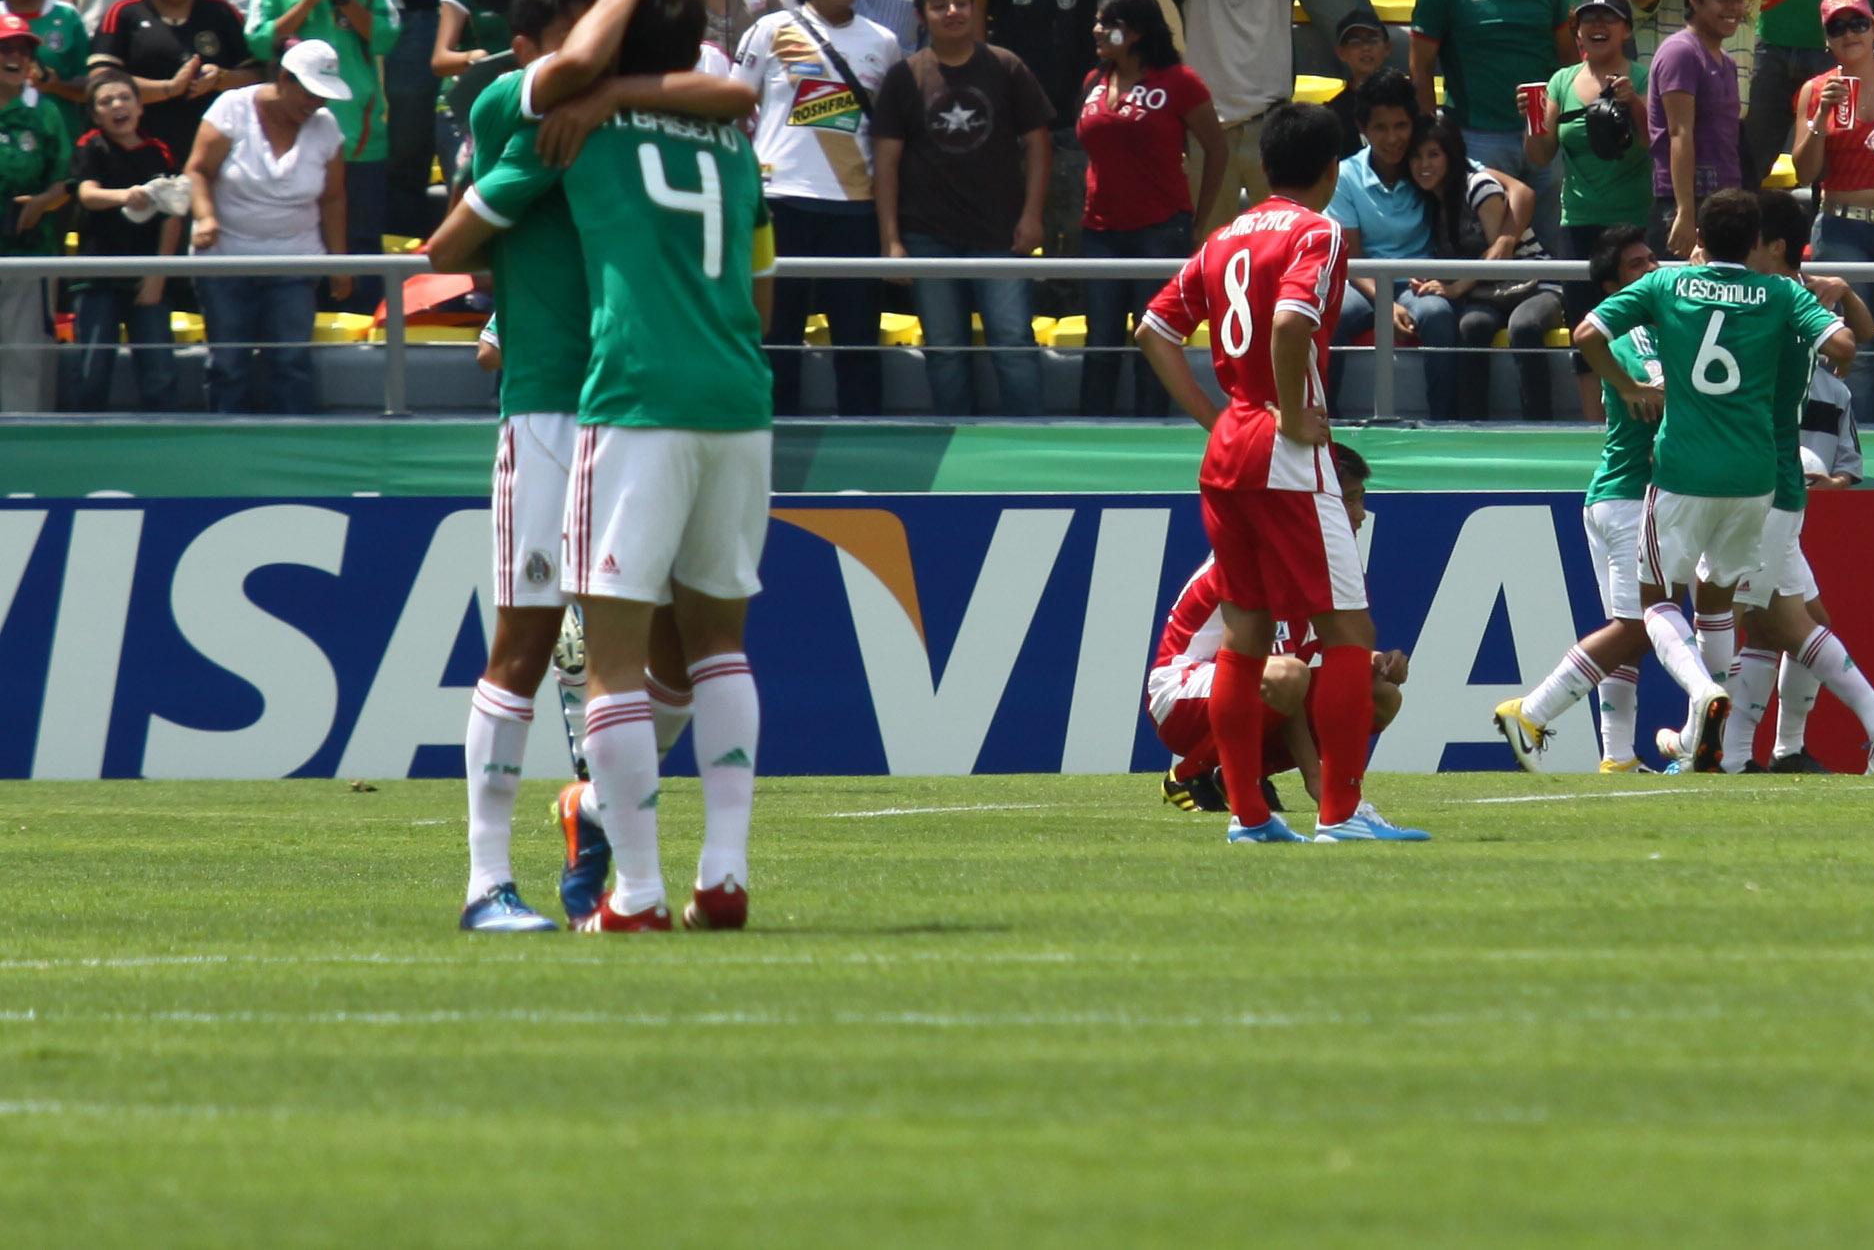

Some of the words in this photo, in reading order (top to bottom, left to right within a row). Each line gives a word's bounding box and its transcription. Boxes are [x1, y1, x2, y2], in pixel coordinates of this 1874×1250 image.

[637, 142, 724, 280] 4
[1220, 248, 1254, 359] 8
[1691, 309, 1741, 396] 6
